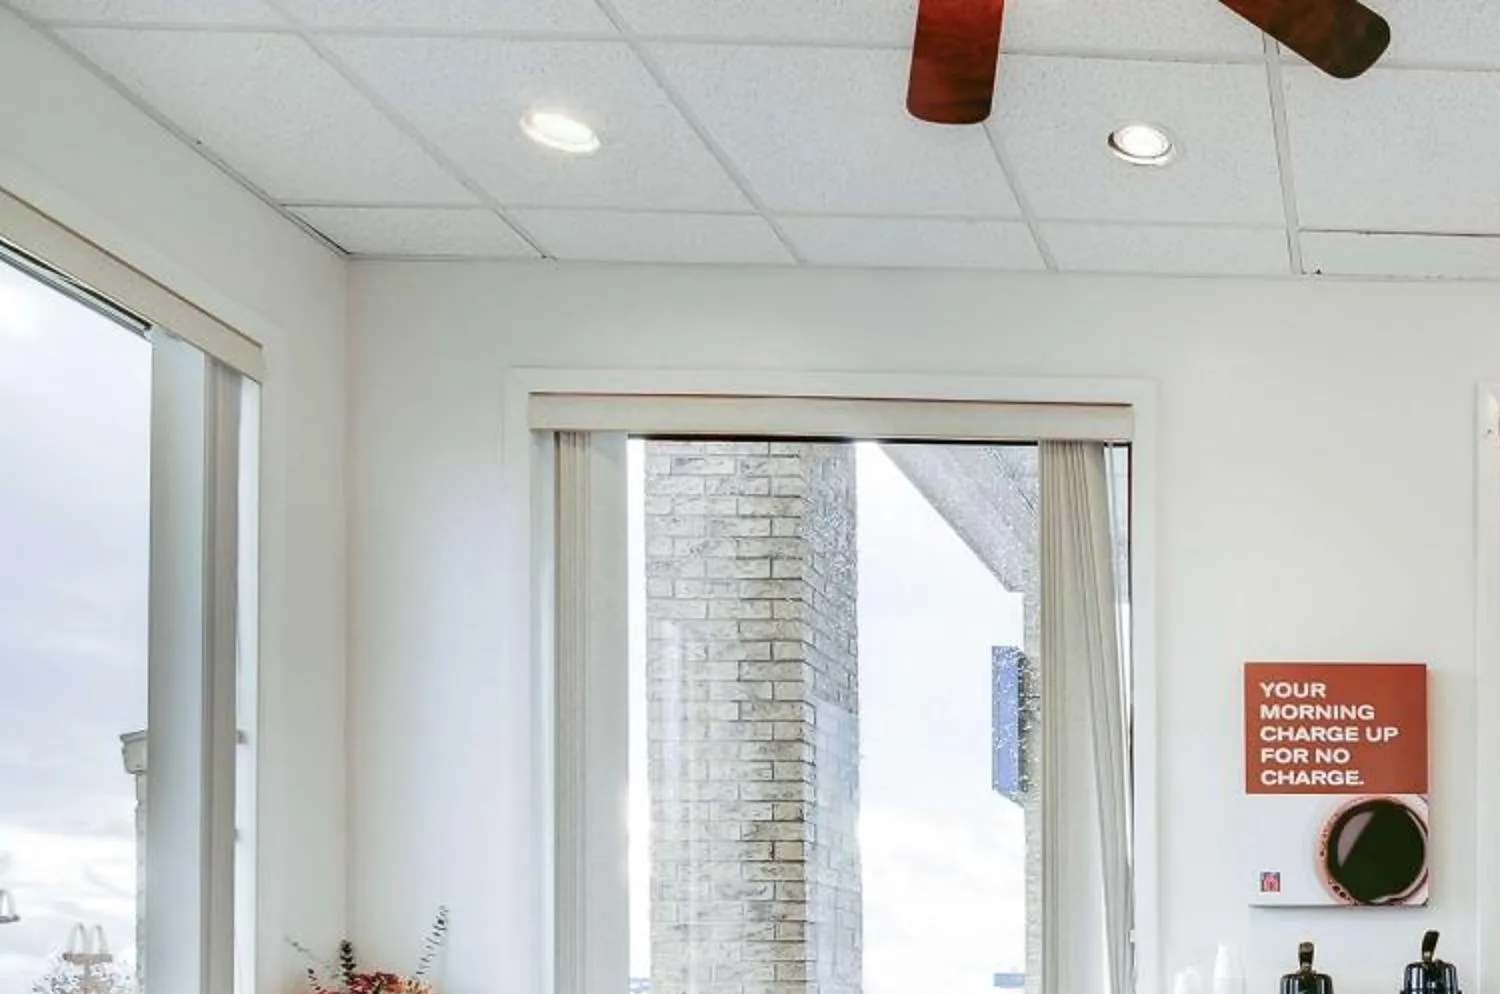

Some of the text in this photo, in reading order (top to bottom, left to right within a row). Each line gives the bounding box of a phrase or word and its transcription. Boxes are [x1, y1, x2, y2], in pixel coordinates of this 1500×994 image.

[1259, 682, 1327, 698] YOUR
[1259, 704, 1375, 720] MORNING
[1259, 726, 1399, 742] CHARGE UP
[1260, 748, 1351, 764] FOR NO
[1260, 769, 1365, 785] CHARGE.
